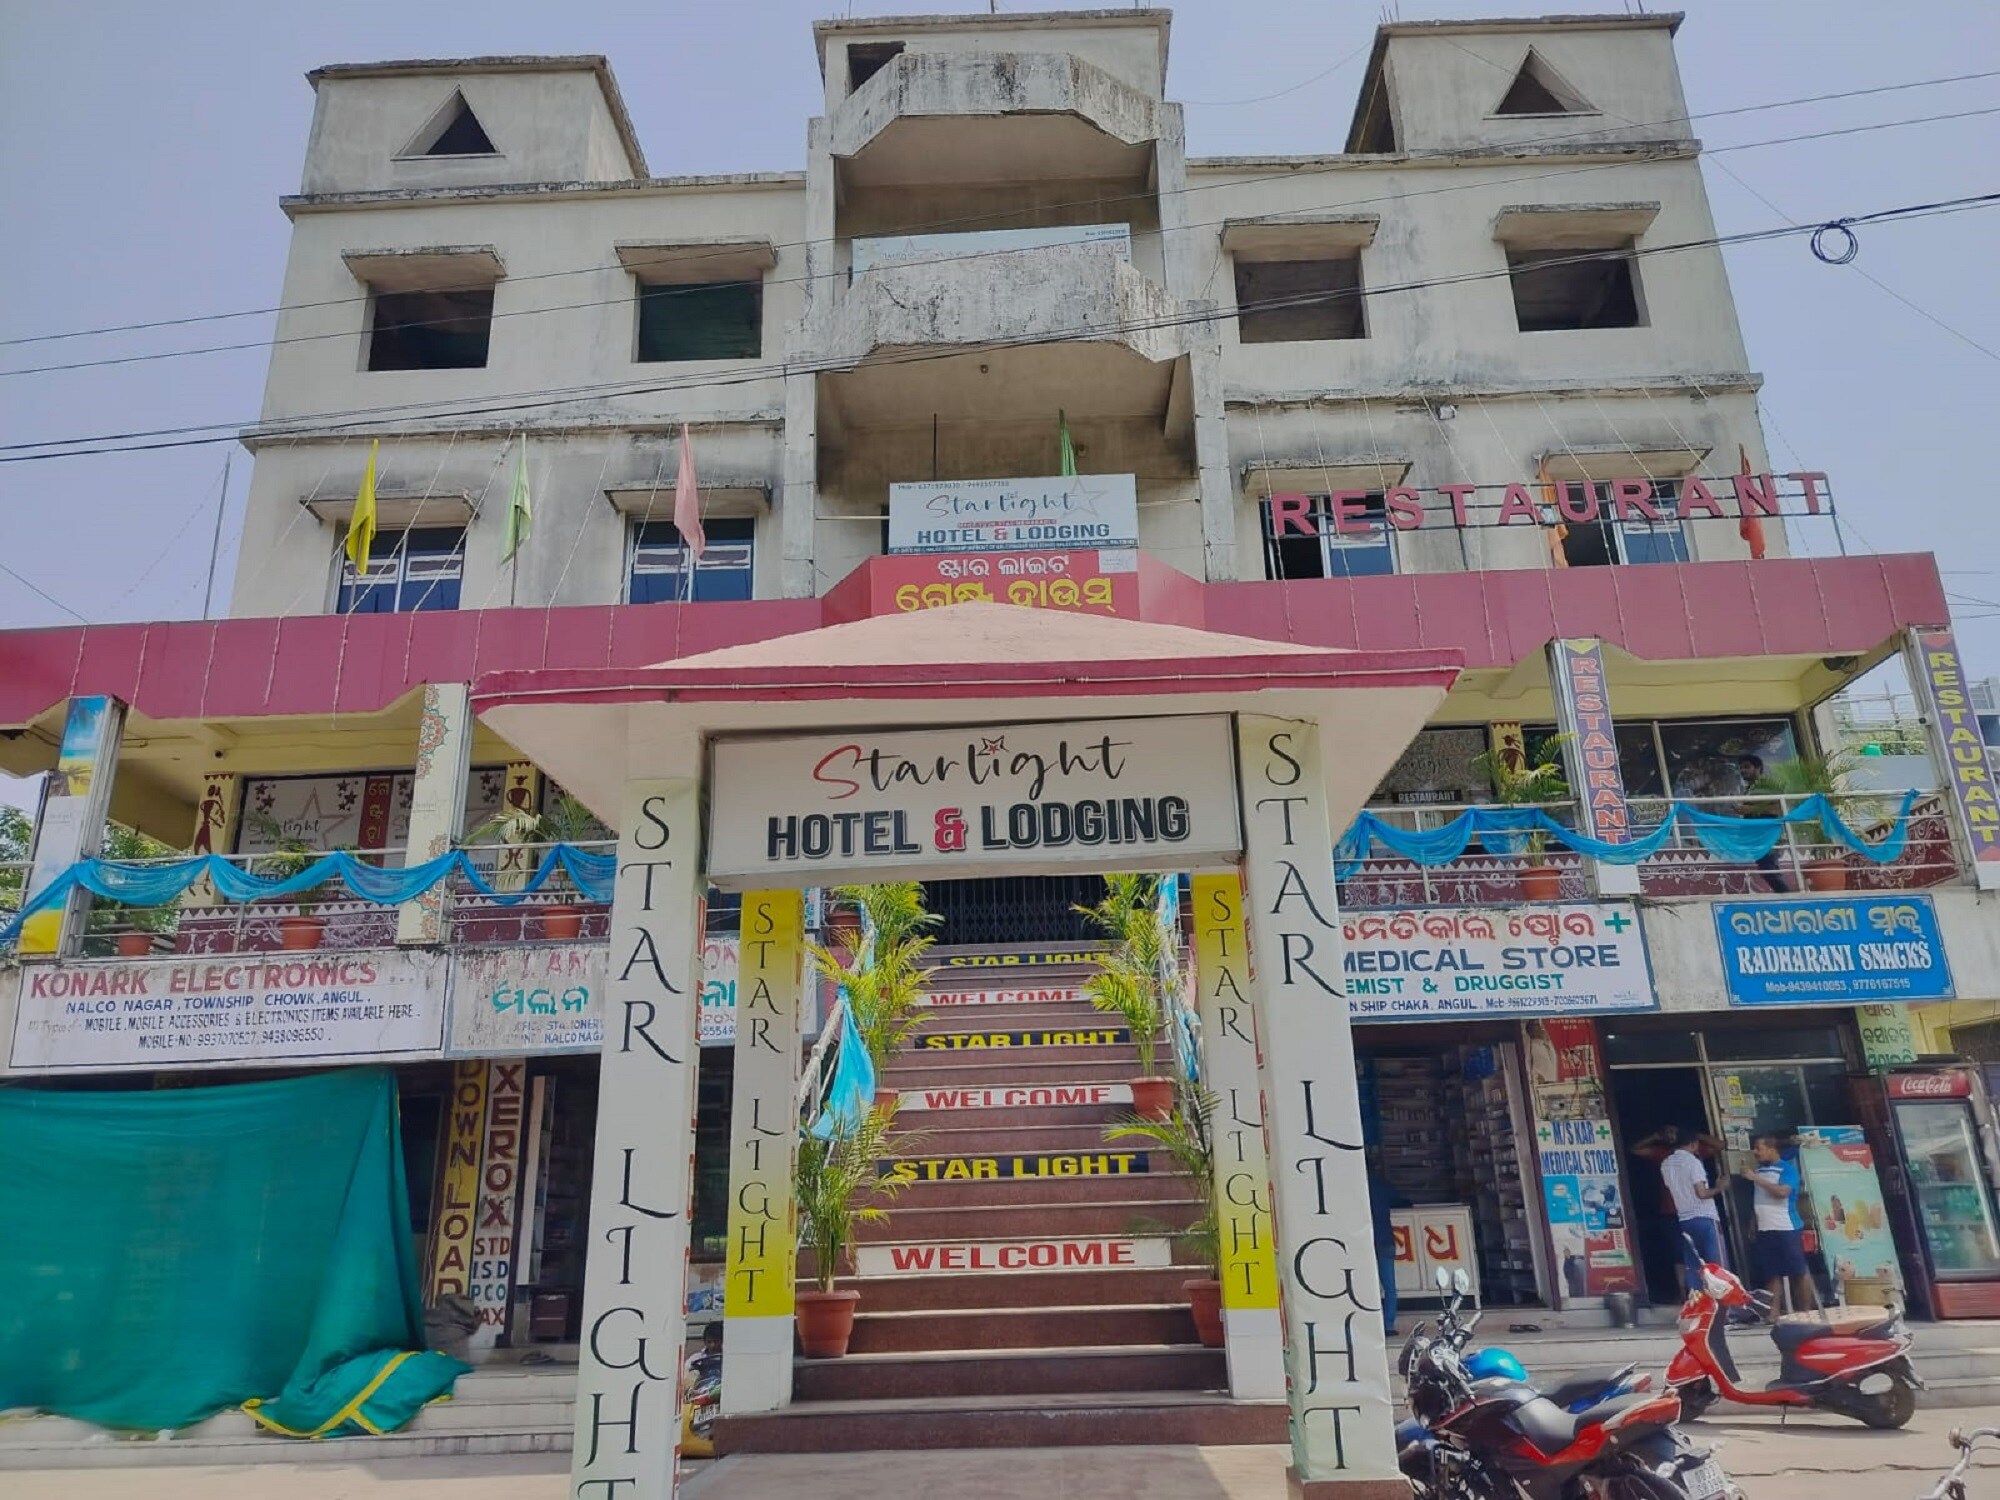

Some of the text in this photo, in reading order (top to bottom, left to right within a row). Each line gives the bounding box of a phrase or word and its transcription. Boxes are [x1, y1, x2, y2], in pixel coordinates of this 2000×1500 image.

[926, 491, 1076, 519] Starlight
[1272, 472, 1826, 538] RESTAURANT
[917, 528, 987, 544] HOTEL
[993, 527, 1008, 542] &
[1016, 523, 1110, 540] LODGING
[1571, 657, 1626, 845] RESTAURANT
[1928, 652, 2000, 843] RESTAURANT
[812, 735, 1134, 800] Starlight
[1398, 790, 1456, 803] RESTAURANT
[766, 795, 1191, 859] HOTEL & LODGING
[619, 796, 685, 1065] STAR
[949, 954, 1020, 967] STAR
[1501, 943, 1621, 970] STORE
[1736, 940, 1932, 975] RADHARANI SNACKS
[30, 962, 377, 998] KONARK ELECTRONICS
[1422, 977, 1439, 993] &
[1455, 973, 1564, 992] DRUGGIST
[66, 1000, 116, 1014] NALCO
[169, 1013, 230, 1030] ACCESSORIES
[245, 1009, 309, 1026] ELECTRONICS
[311, 1007, 340, 1022] ITEMS
[342, 1005, 384, 1021] AVAILABLE
[1360, 1000, 1387, 1012] SHIP
[544, 1032, 577, 1044] NALCO
[547, 1018, 603, 1031] STAIONER
[925, 1030, 1120, 1050] STAR LIGHT
[733, 903, 785, 1302] STAR LIGHT
[924, 1087, 1111, 1109] WELCOME
[1206, 889, 1271, 1295] STAR LIGHT
[1256, 733, 1381, 1470] STAR LIGHT
[1552, 1119, 1596, 1146] M/S KAR
[480, 1064, 524, 1229] XEROX
[893, 1154, 1136, 1180] STAR LIGHT
[1541, 1149, 1617, 1176] MEDICAL STORE
[439, 1060, 484, 1299] DOWN LOAD
[474, 1237, 511, 1256] STD
[891, 1242, 1136, 1271] WELCOME
[476, 1307, 505, 1326] AX
